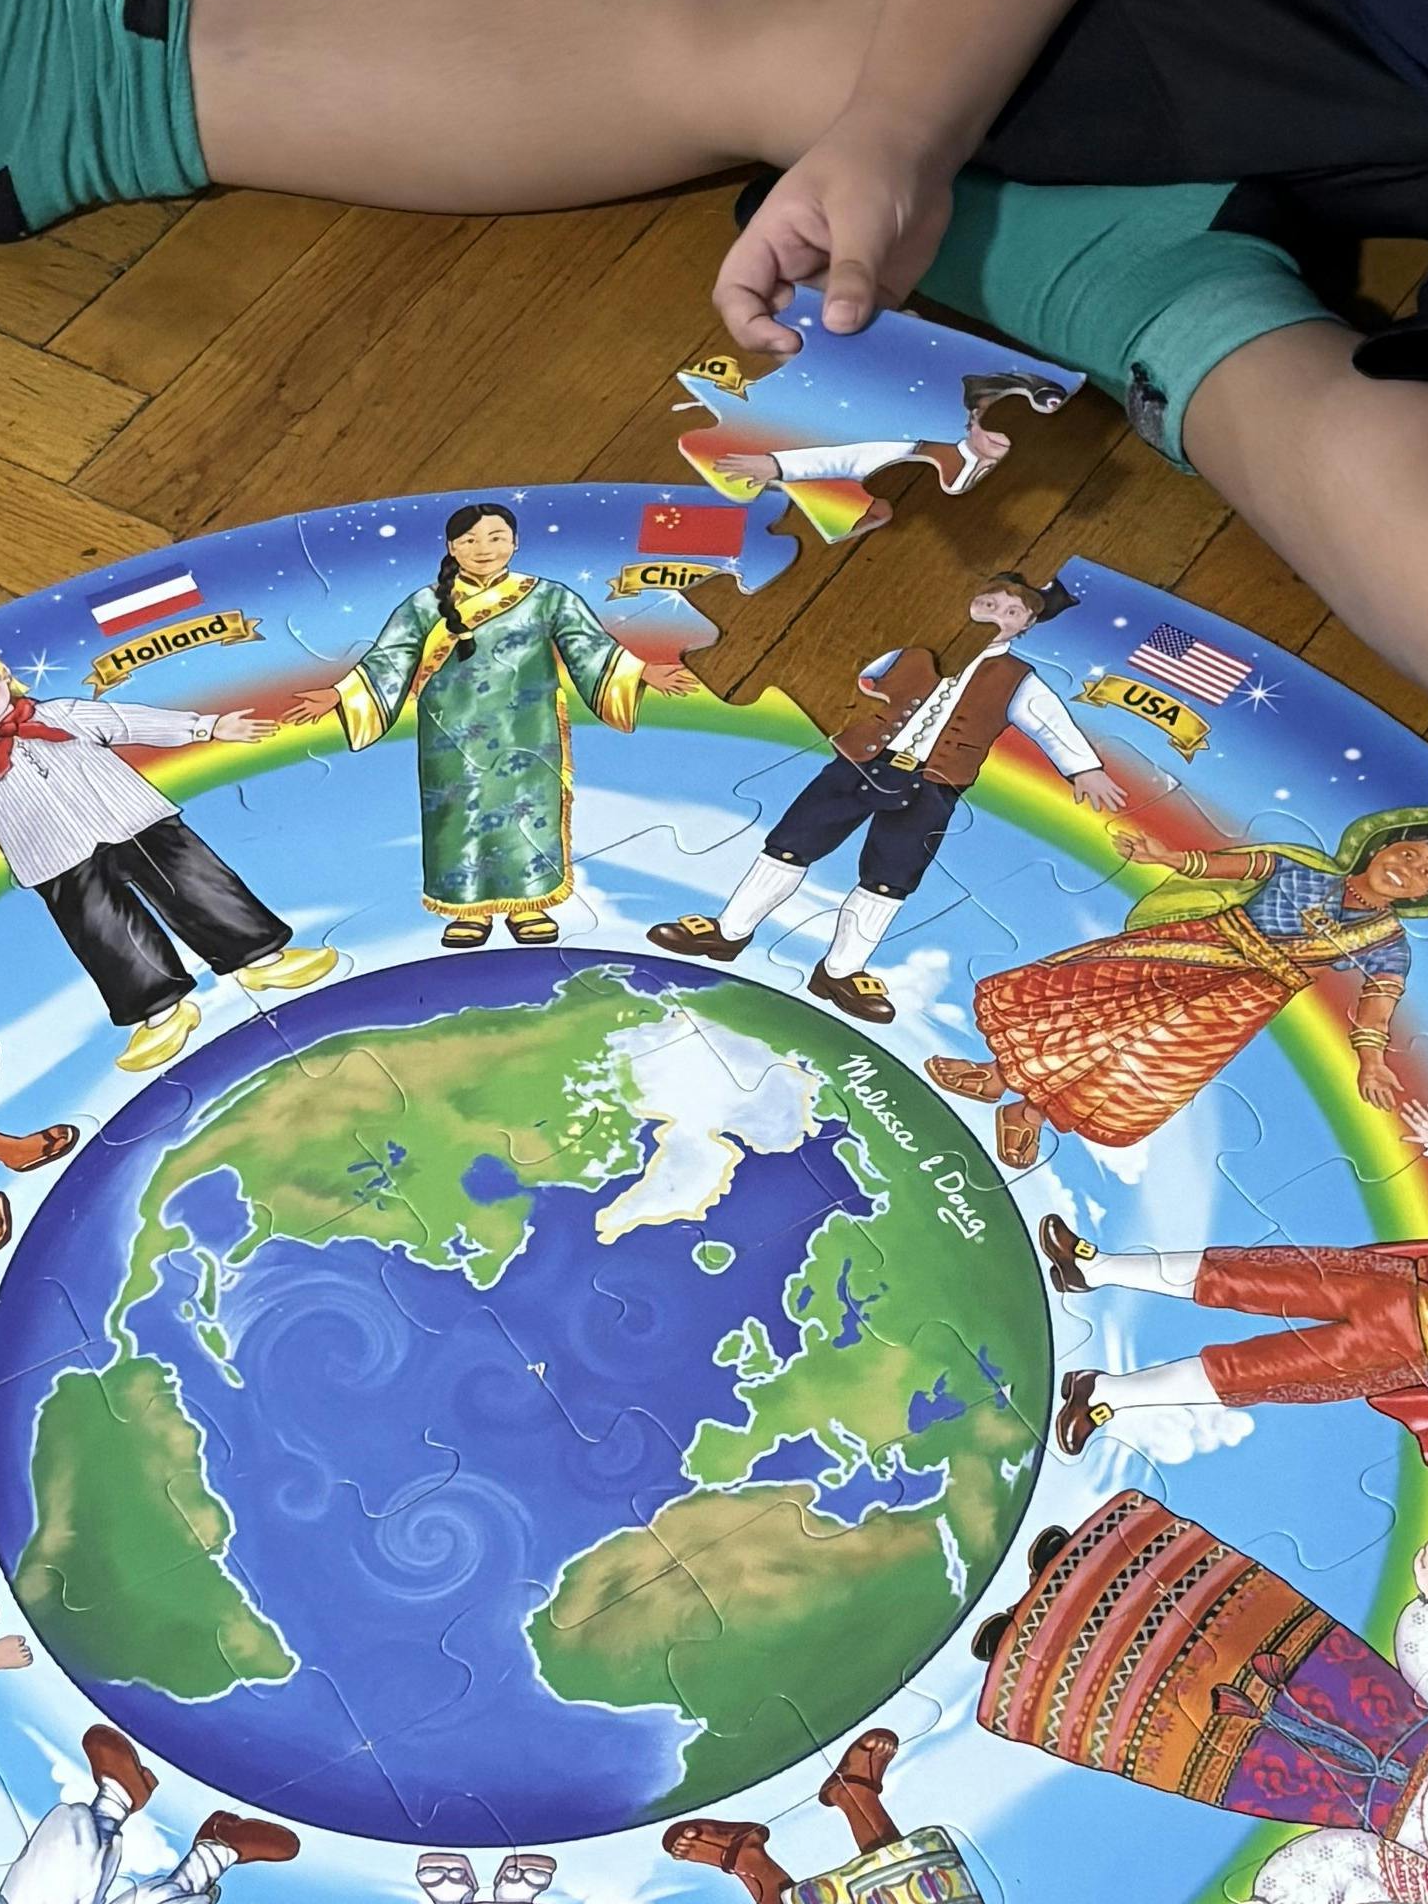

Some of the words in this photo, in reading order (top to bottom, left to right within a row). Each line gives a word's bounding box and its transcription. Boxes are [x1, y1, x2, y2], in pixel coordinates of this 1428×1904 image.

[110, 615, 229, 670] Holland
[1123, 684, 1181, 726] USA
[837, 1053, 919, 1153] Melissa
[934, 1171, 987, 1240] Doug
